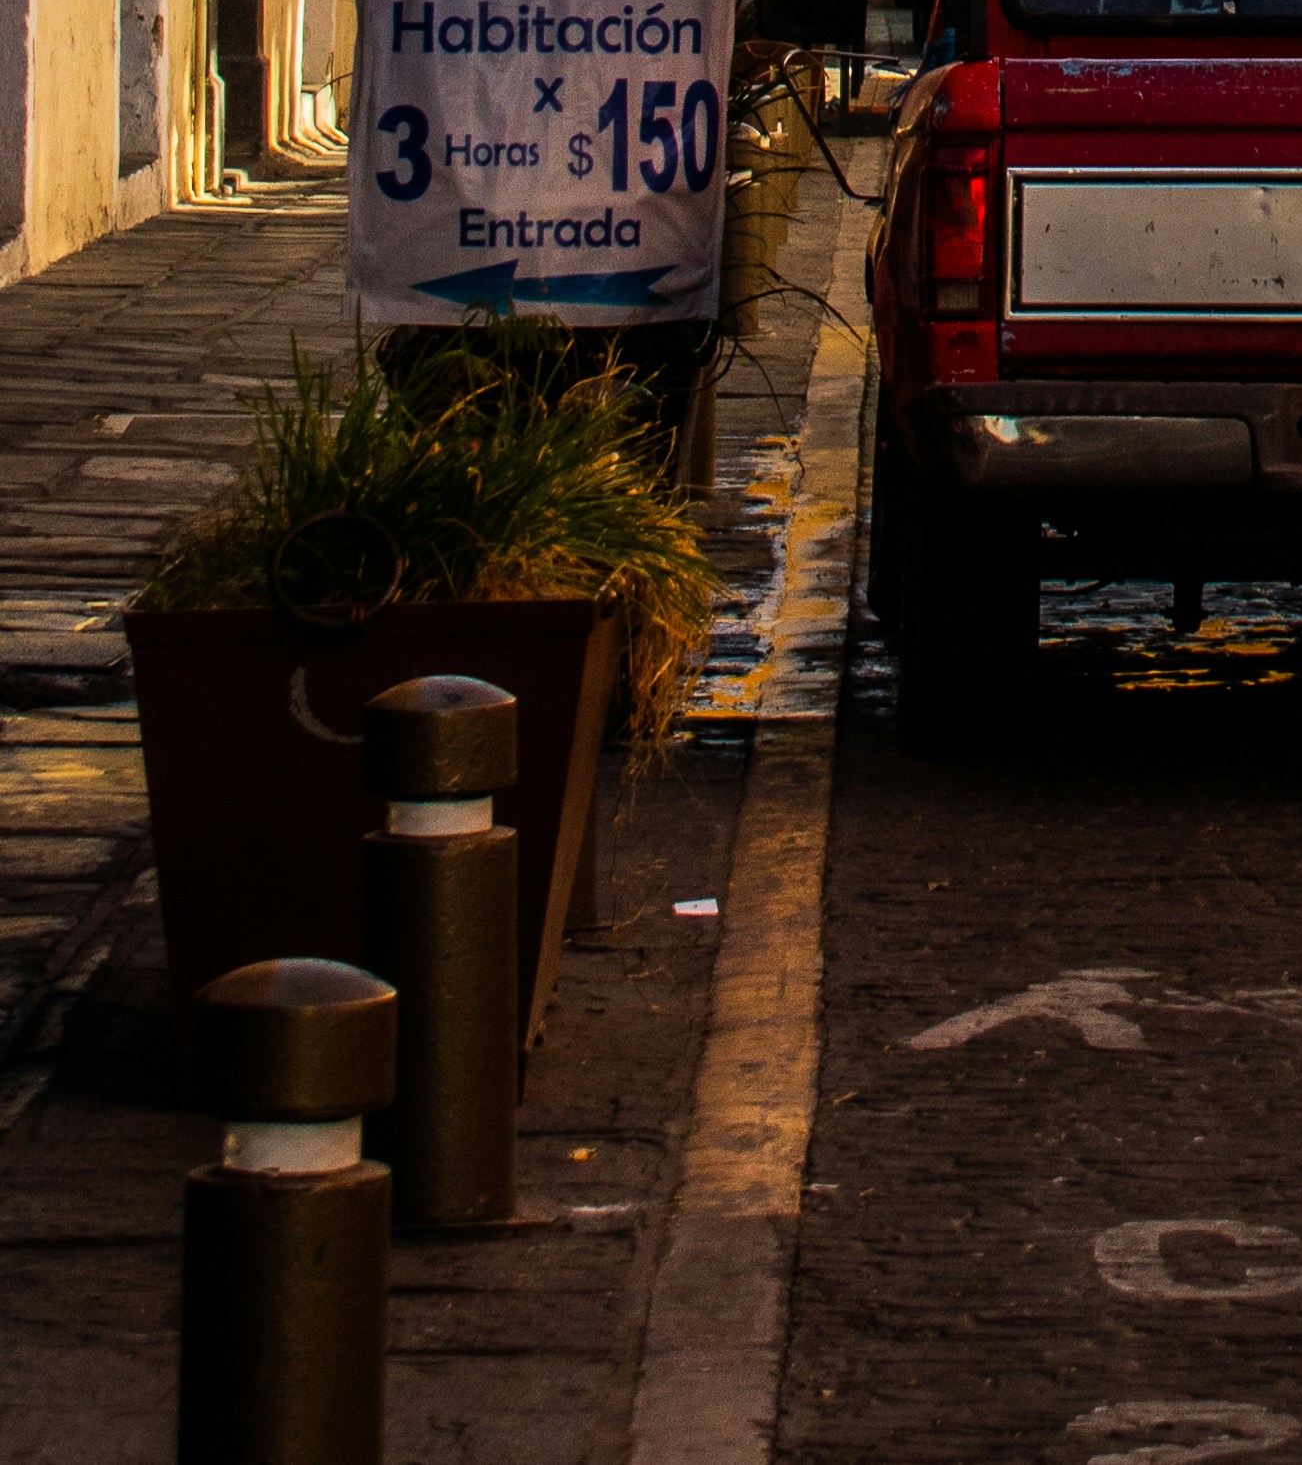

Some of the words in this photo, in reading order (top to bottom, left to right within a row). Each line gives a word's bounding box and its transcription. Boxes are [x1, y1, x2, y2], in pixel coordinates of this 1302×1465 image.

[391, 1, 701, 54] Habitación
[375, 104, 433, 201] 3
[444, 134, 540, 168] Horas
[458, 208, 641, 249] Entrada
